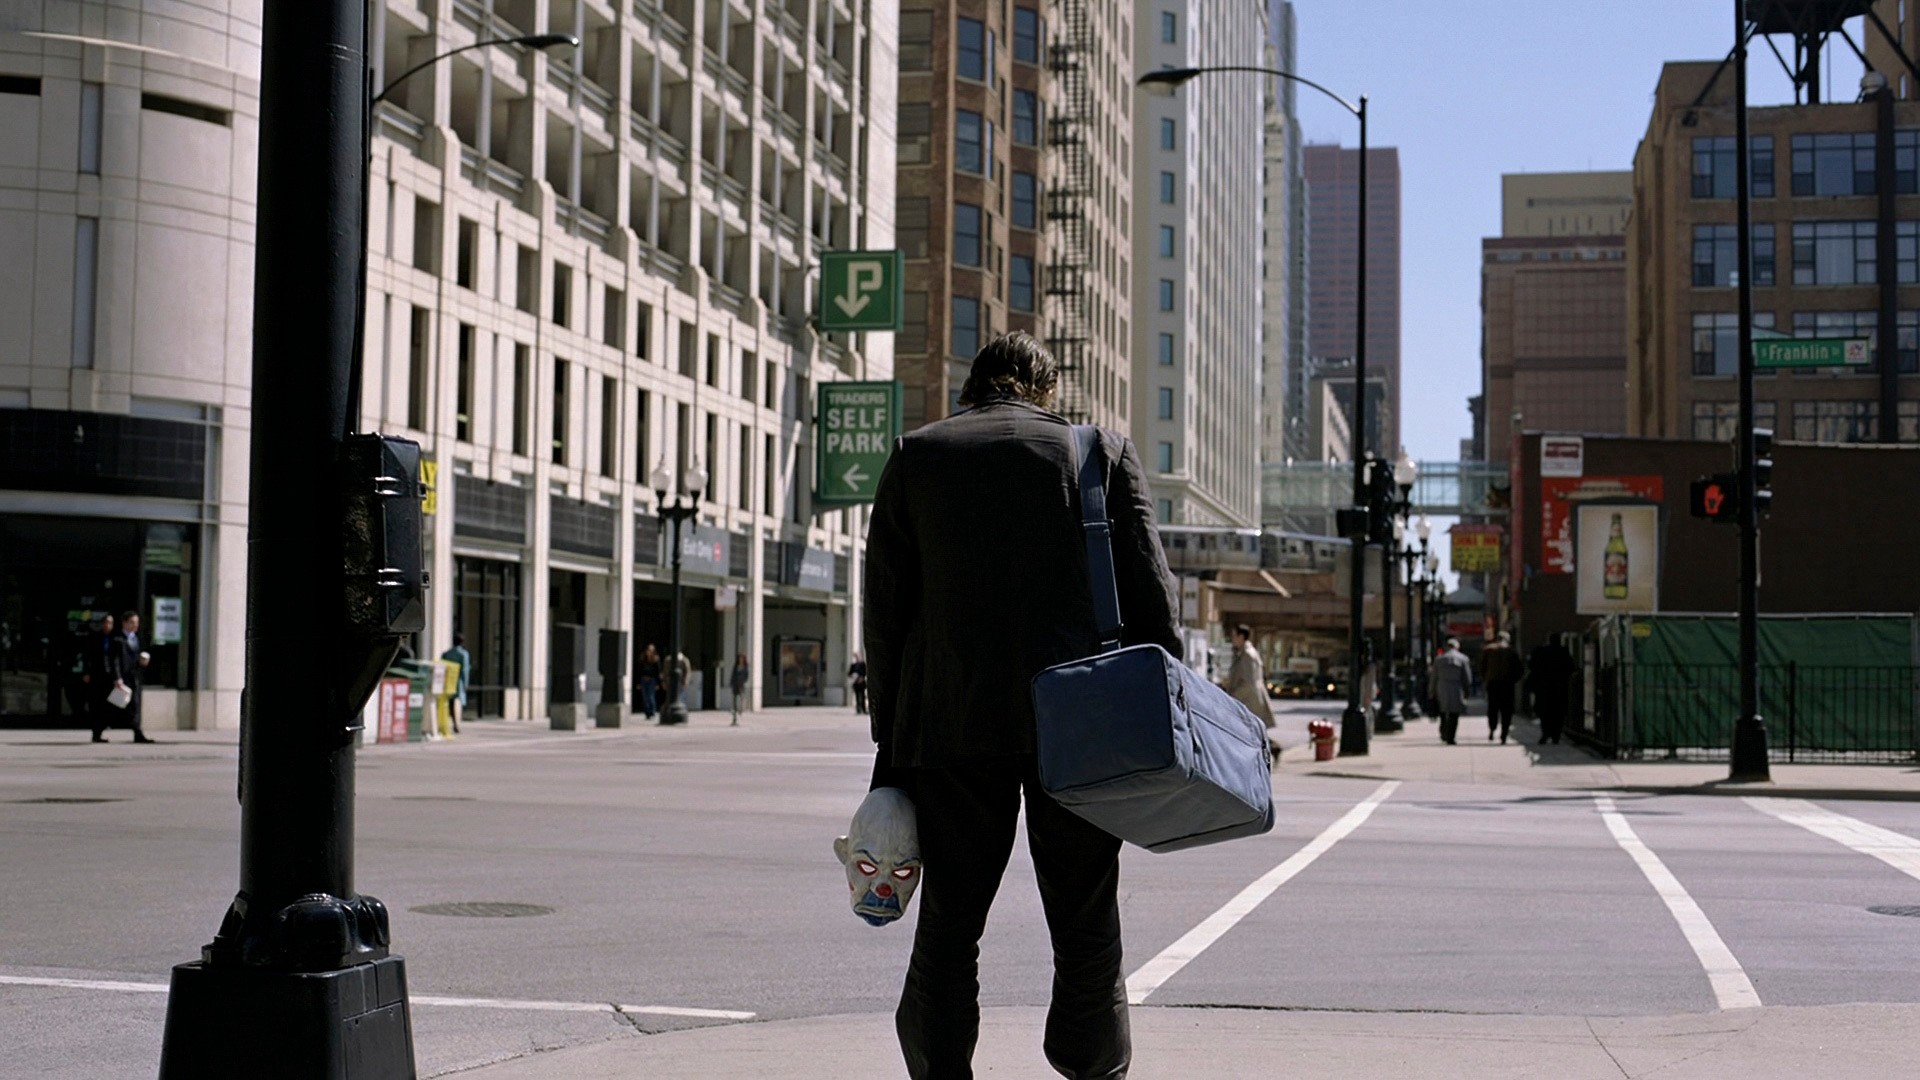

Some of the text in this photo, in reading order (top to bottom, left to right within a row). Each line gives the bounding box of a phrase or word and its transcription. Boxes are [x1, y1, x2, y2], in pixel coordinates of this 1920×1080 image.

[845, 261, 883, 317] P
[1769, 344, 1829, 361] Franklin
[828, 392, 886, 405] TRADERS
[826, 408, 886, 429] SELF
[826, 432, 886, 453] PARK
